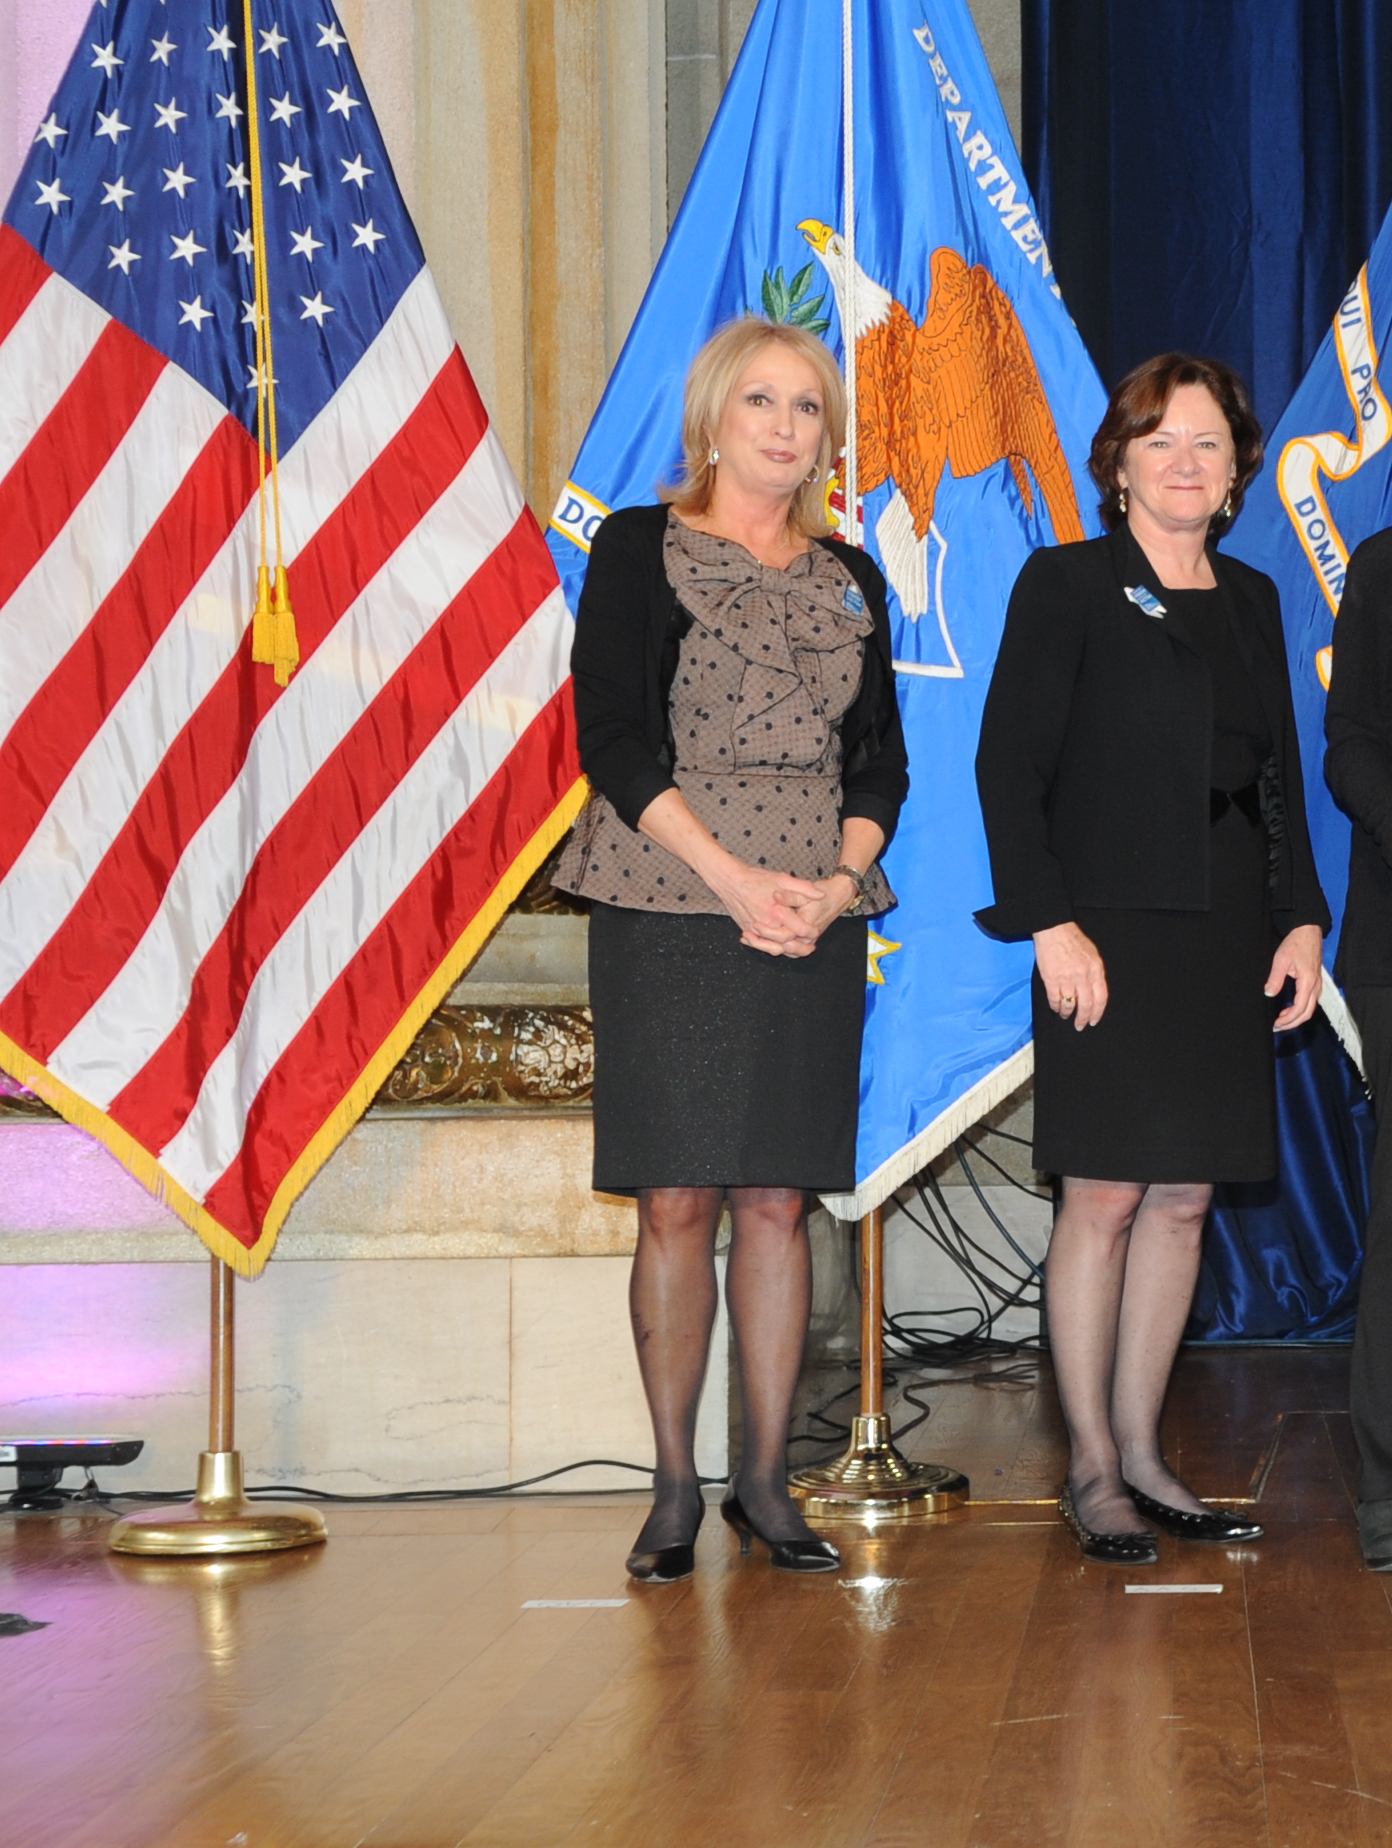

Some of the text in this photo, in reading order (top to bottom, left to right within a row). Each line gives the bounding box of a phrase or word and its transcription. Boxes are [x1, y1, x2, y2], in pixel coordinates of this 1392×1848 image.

[913, 20, 1061, 300] DEPARTMEN
[1351, 363, 1378, 421] PRO
[1294, 495, 1346, 599] DOMIN
